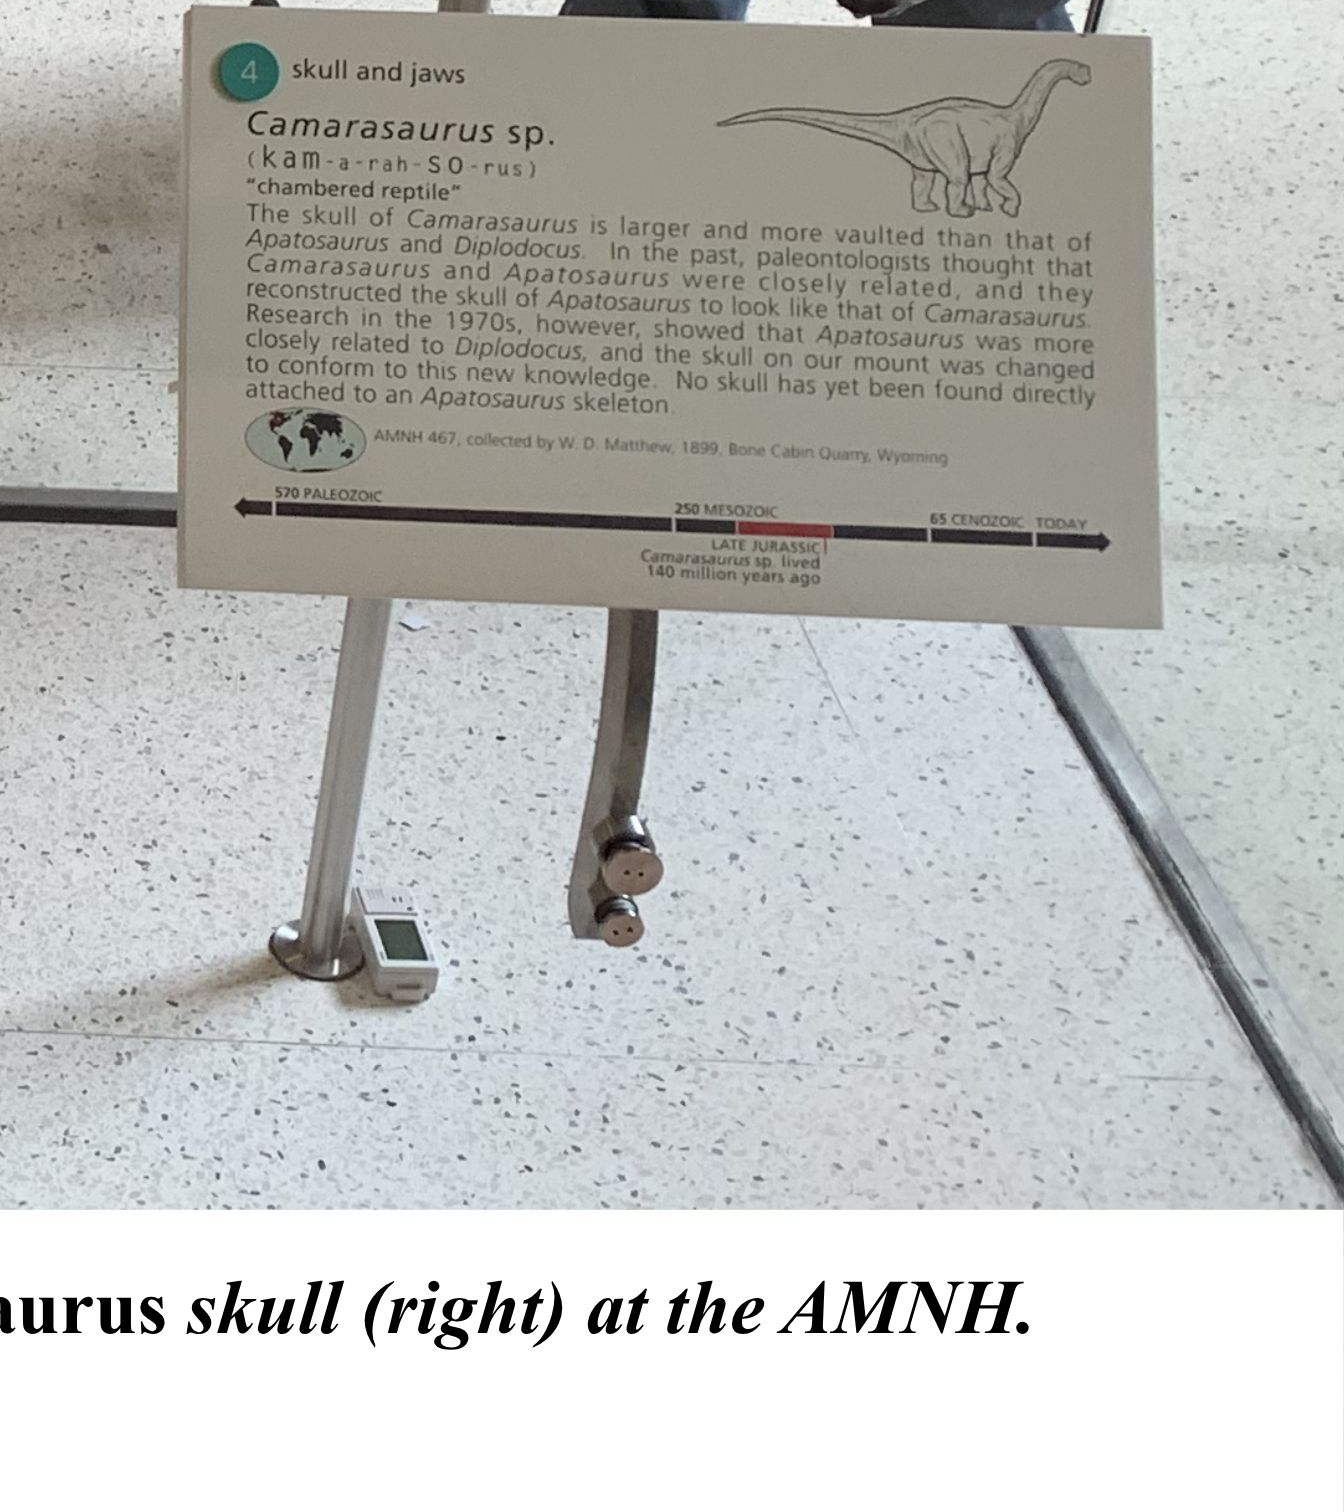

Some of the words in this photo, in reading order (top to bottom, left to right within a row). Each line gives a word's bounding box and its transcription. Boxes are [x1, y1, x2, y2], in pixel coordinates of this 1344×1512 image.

[240, 60, 259, 85] 4
[292, 57, 348, 80] skull
[356, 61, 403, 82] and
[411, 61, 465, 88] jaws
[247, 110, 495, 144] Camarasaurus
[508, 124, 554, 152] sp.
[246, 202, 290, 225] The
[301, 204, 357, 227] skull
[368, 207, 393, 228] of
[407, 208, 578, 235] Camarasaurus
[590, 219, 608, 236] is
[620, 215, 691, 243] larger
[703, 220, 748, 241] and
[761, 225, 823, 244] more
[834, 224, 925, 247] vaulted
[937, 226, 992, 249] than
[1005, 228, 1055, 252] that
[1067, 231, 1092, 252] of
[244, 228, 390, 255] Apatosaurus
[399, 233, 443, 255] and
[453, 234, 585, 264] Diplodocus.
[610, 241, 630, 261] In
[641, 238, 679, 264] the
[690, 247, 745, 269] past,
[757, 246, 931, 276] paleontologists
[942, 252, 1035, 280] thought
[1046, 256, 1093, 278] that
[247, 252, 431, 280] Camarasaurus
[443, 260, 491, 282] and
[502, 262, 669, 289] Apatosaurus
[681, 273, 745, 291] were
[758, 270, 847, 299] closely
[860, 273, 960, 302] related,
[975, 277, 1023, 301] and
[1037, 280, 1093, 308] they
[373, 428, 424, 444] AMNH
[465, 432, 533, 449] collected
[536, 434, 555, 452] by
[728, 441, 766, 457] Bone
[769, 443, 815, 459] Cabin
[876, 447, 949, 468] Wyoming
[274, 486, 300, 500] 570
[303, 487, 383, 503] PALEOZOIC
[674, 502, 702, 516] 250
[703, 503, 779, 519] MESOZOIC
[929, 513, 948, 526] 65
[950, 513, 1024, 530] CENOZOIC
[1035, 517, 1088, 531] TODAY
[640, 548, 751, 568] Camarasaurus
[781, 553, 821, 571] lived
[711, 538, 747, 552] LATE
[751, 539, 821, 555] JURASSIC
[647, 563, 676, 579] 140
[680, 565, 738, 581] million
[741, 571, 785, 586] years
[788, 573, 821, 589] ago
